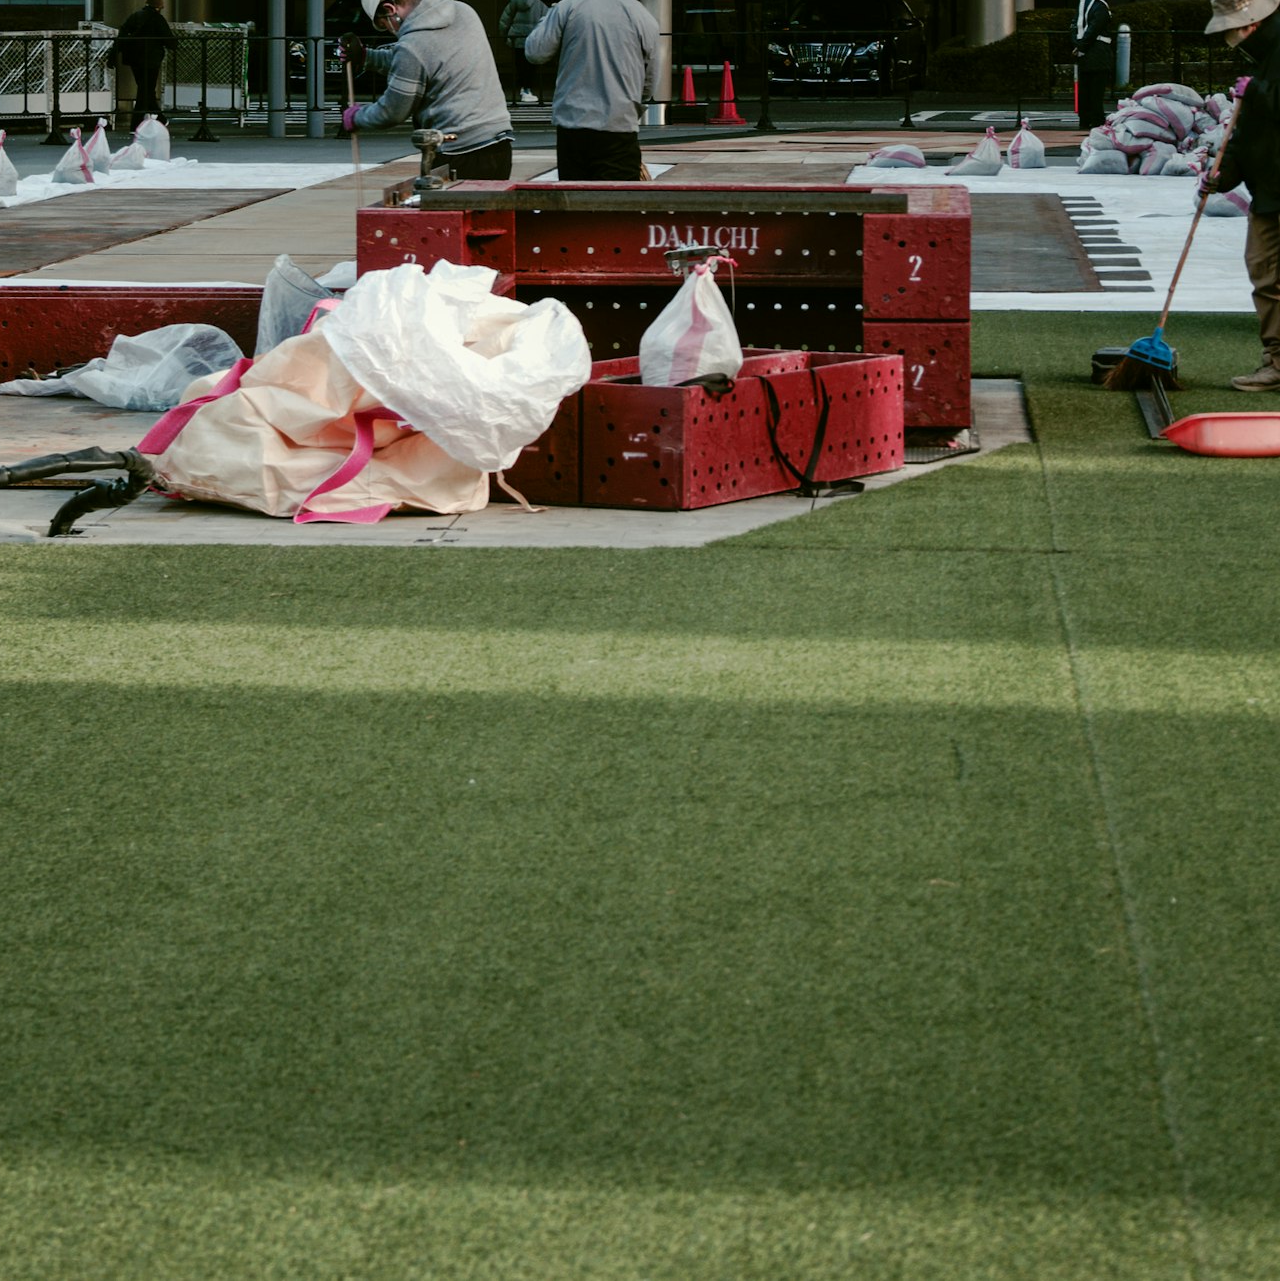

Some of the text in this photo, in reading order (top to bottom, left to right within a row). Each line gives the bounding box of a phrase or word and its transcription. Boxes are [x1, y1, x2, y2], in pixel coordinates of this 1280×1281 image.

[648, 224, 760, 249] DAIICHI
[908, 255, 923, 282] 2
[910, 364, 925, 391] 2
